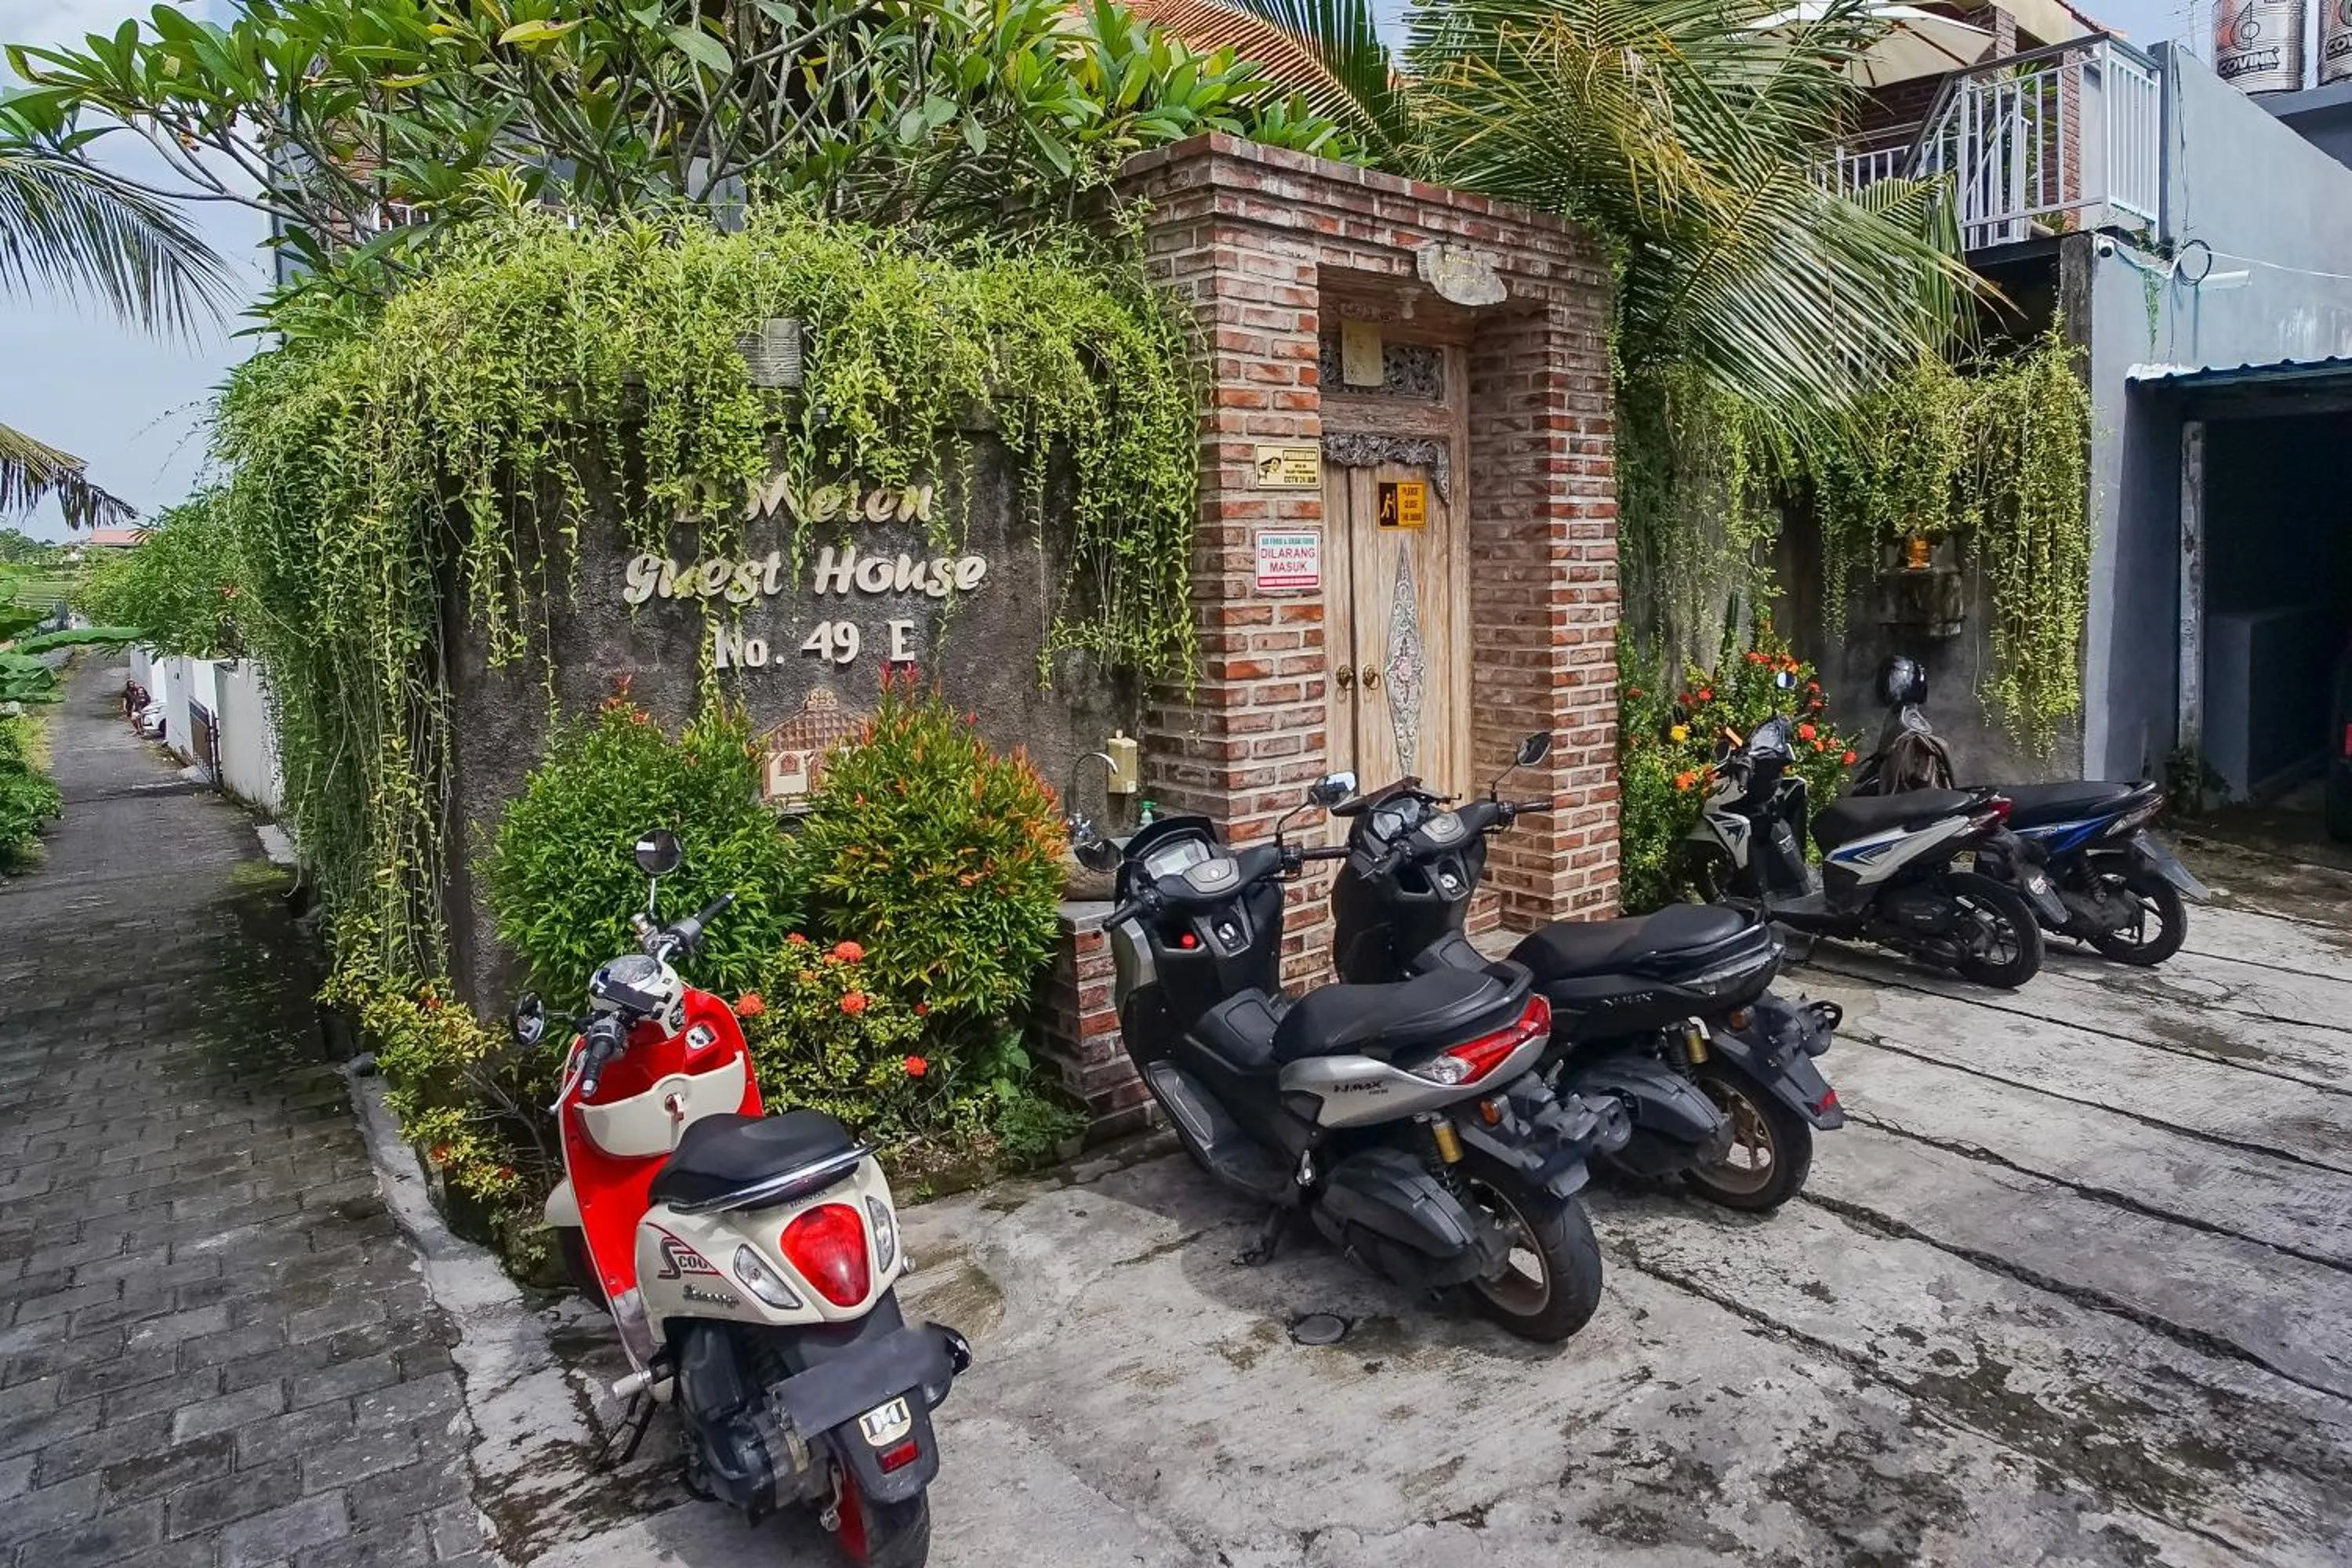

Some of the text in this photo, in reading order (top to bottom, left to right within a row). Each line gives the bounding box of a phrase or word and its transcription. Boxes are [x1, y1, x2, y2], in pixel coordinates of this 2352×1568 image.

[2219, 50, 2278, 74] COVINA
[1261, 548, 1315, 559] DILARANG
[623, 546, 987, 604] Guest House
[1270, 561, 1307, 572] MASUK
[714, 619, 915, 668] No. 49 E
